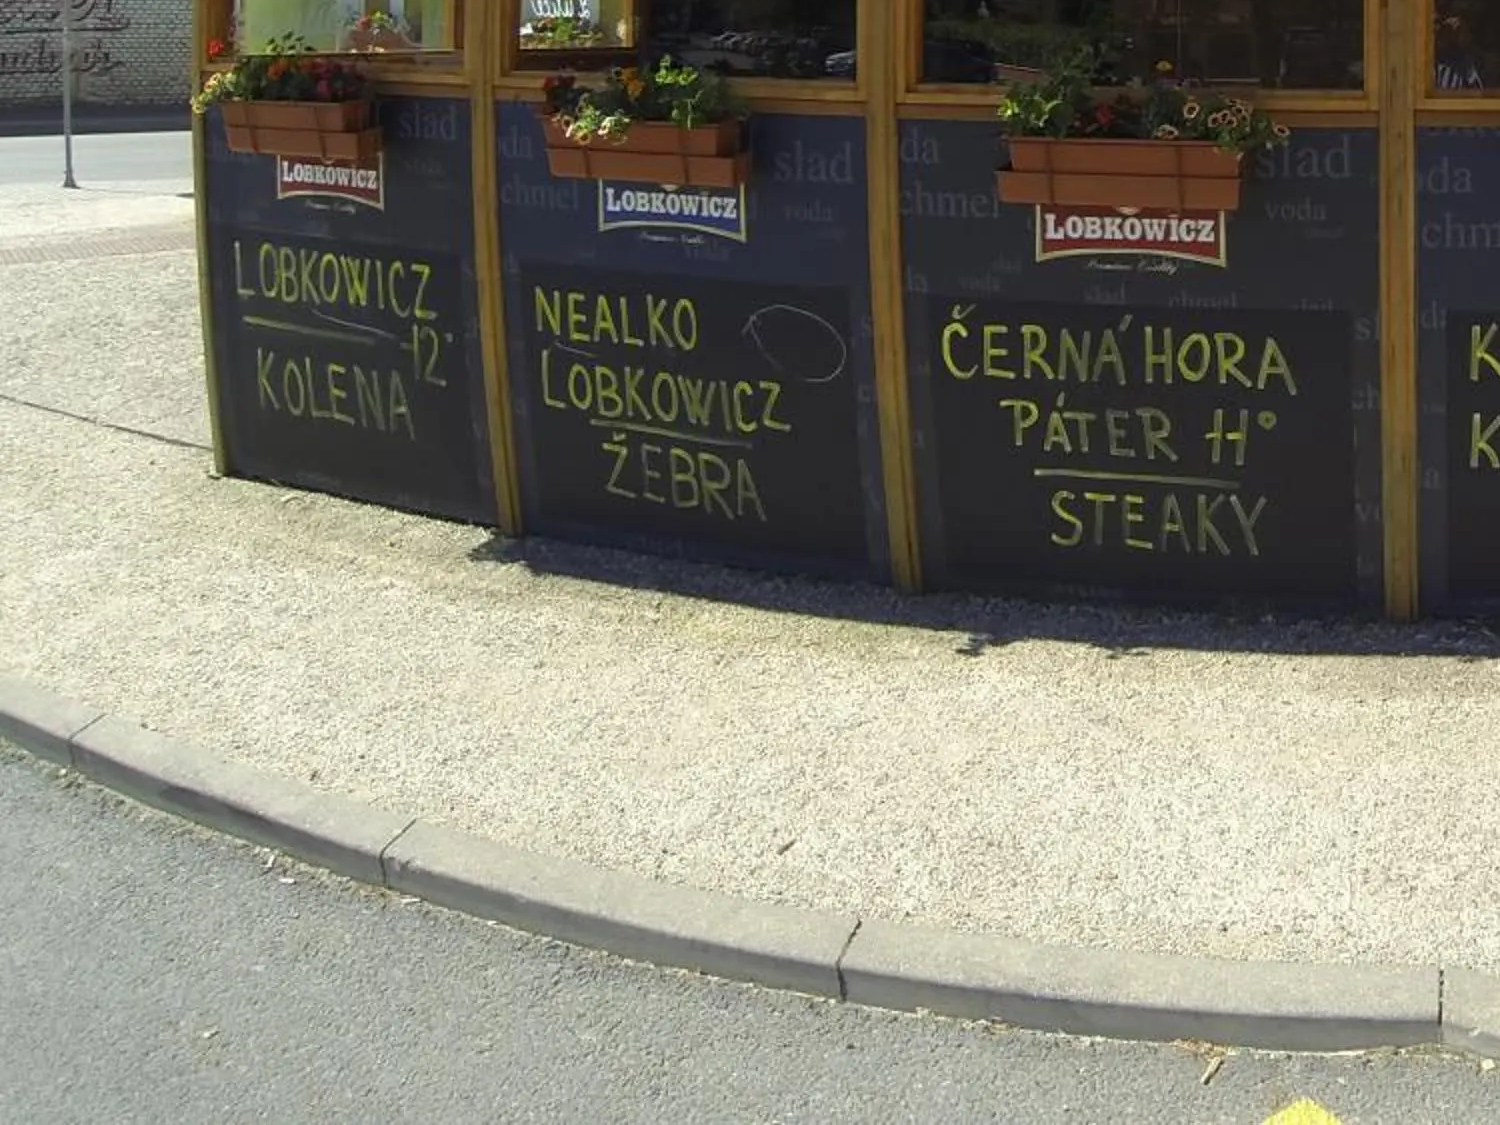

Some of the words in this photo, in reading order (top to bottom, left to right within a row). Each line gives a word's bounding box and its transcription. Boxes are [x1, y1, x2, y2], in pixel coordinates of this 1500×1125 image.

[282, 159, 378, 191] LOBKOWICZ
[606, 186, 737, 220] LOBKOWICZ
[1044, 212, 1216, 243] LOBKOWICZ
[233, 239, 439, 321] LOBKOWICZ
[535, 284, 697, 351] NEALKO
[257, 346, 416, 440] KOLENA
[541, 347, 791, 432] LOBKOWICZ
[1144, 325, 1297, 397] HORA
[1000, 391, 1179, 462] PÁTER
[601, 431, 767, 523] ŽEBRA
[1050, 489, 1267, 557] STEAKY
